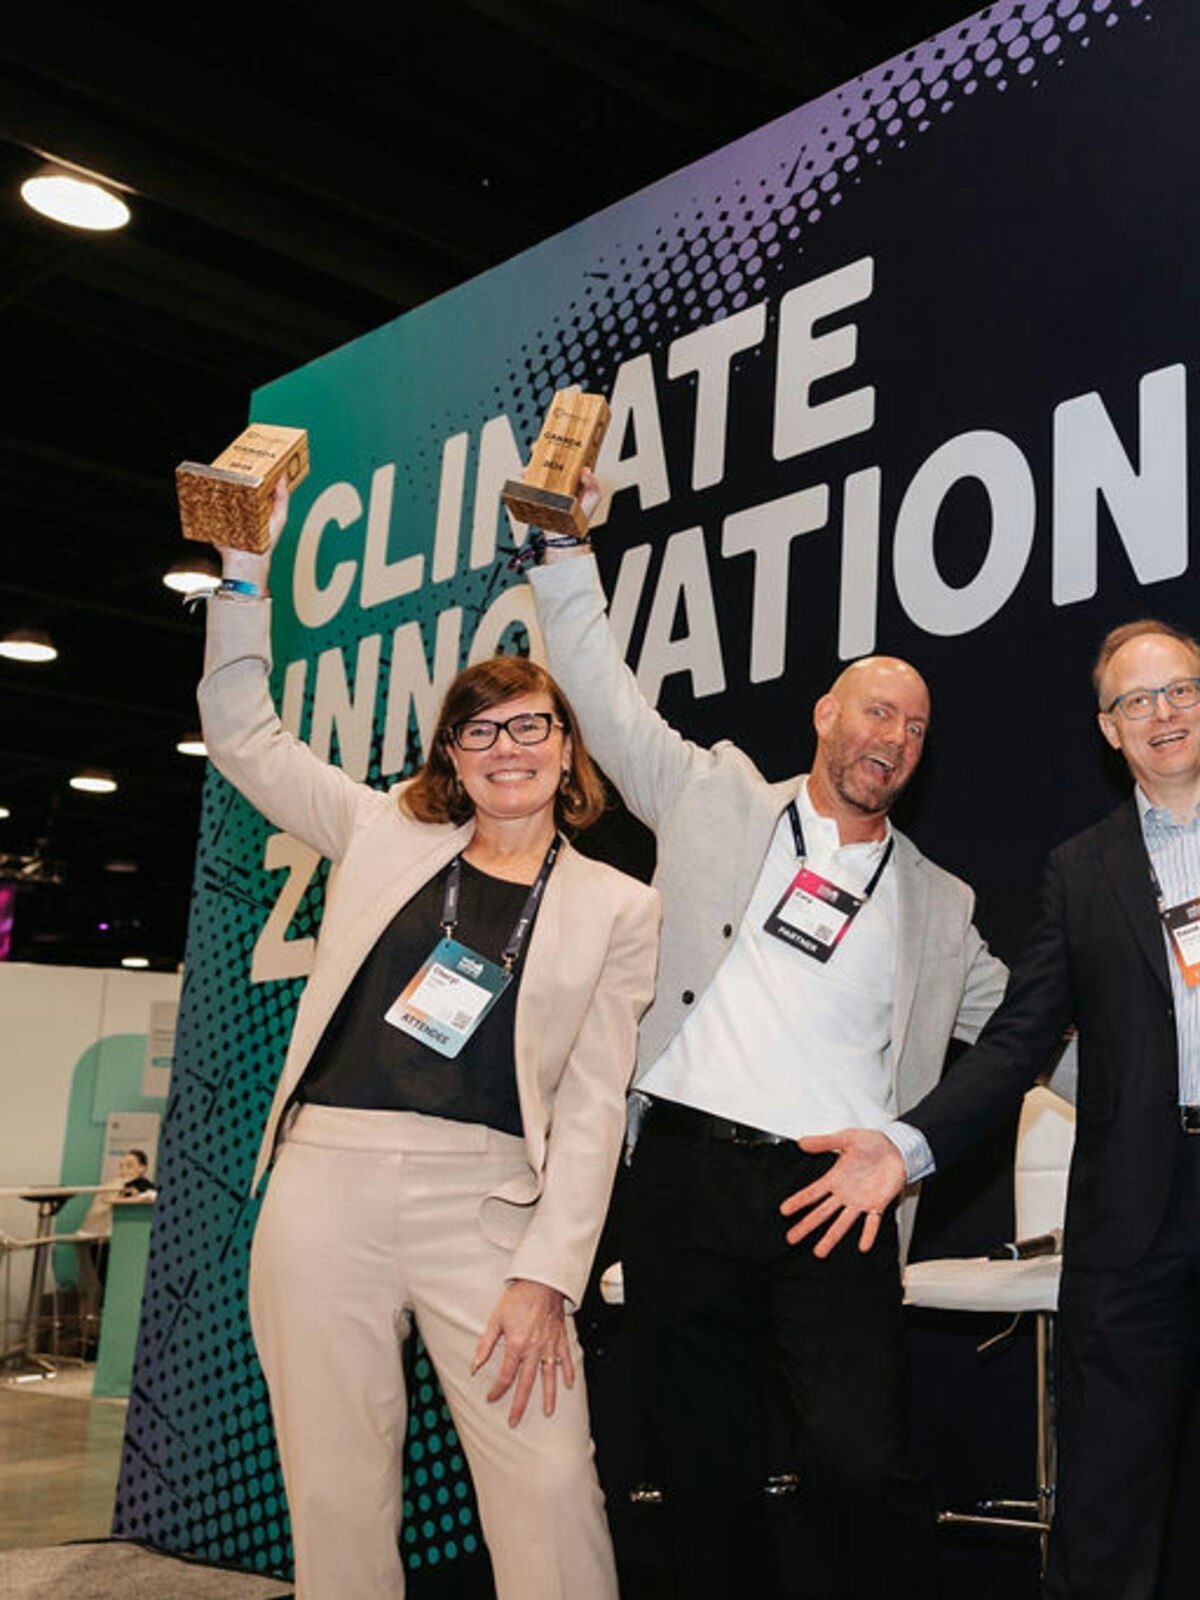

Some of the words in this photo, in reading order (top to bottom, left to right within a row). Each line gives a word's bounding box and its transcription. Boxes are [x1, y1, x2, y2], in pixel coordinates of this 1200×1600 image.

[543, 431, 582, 449] CANADA
[777, 925, 820, 953] PARTNER
[402, 1012, 450, 1045] ATTENDEE
